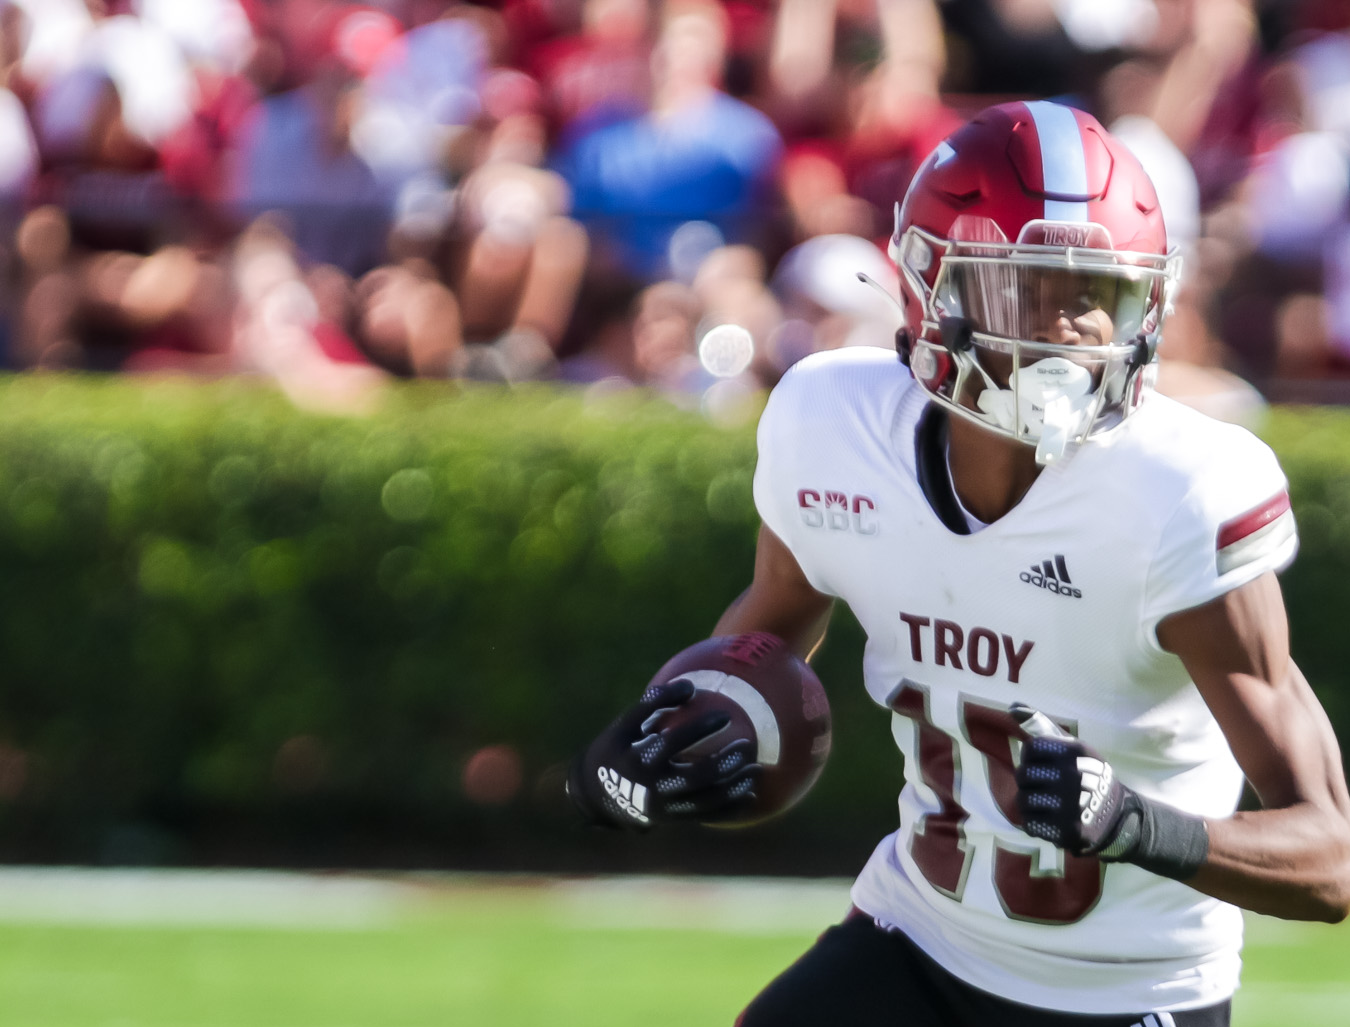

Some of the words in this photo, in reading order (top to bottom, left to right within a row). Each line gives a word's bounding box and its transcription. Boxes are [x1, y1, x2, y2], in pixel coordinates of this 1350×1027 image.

[1043, 224, 1091, 247] TROY
[797, 488, 877, 536] SBC
[1019, 571, 1082, 599] adidas
[900, 611, 1035, 684] TROY
[597, 766, 649, 823] adidas
[885, 677, 1108, 926] 15
